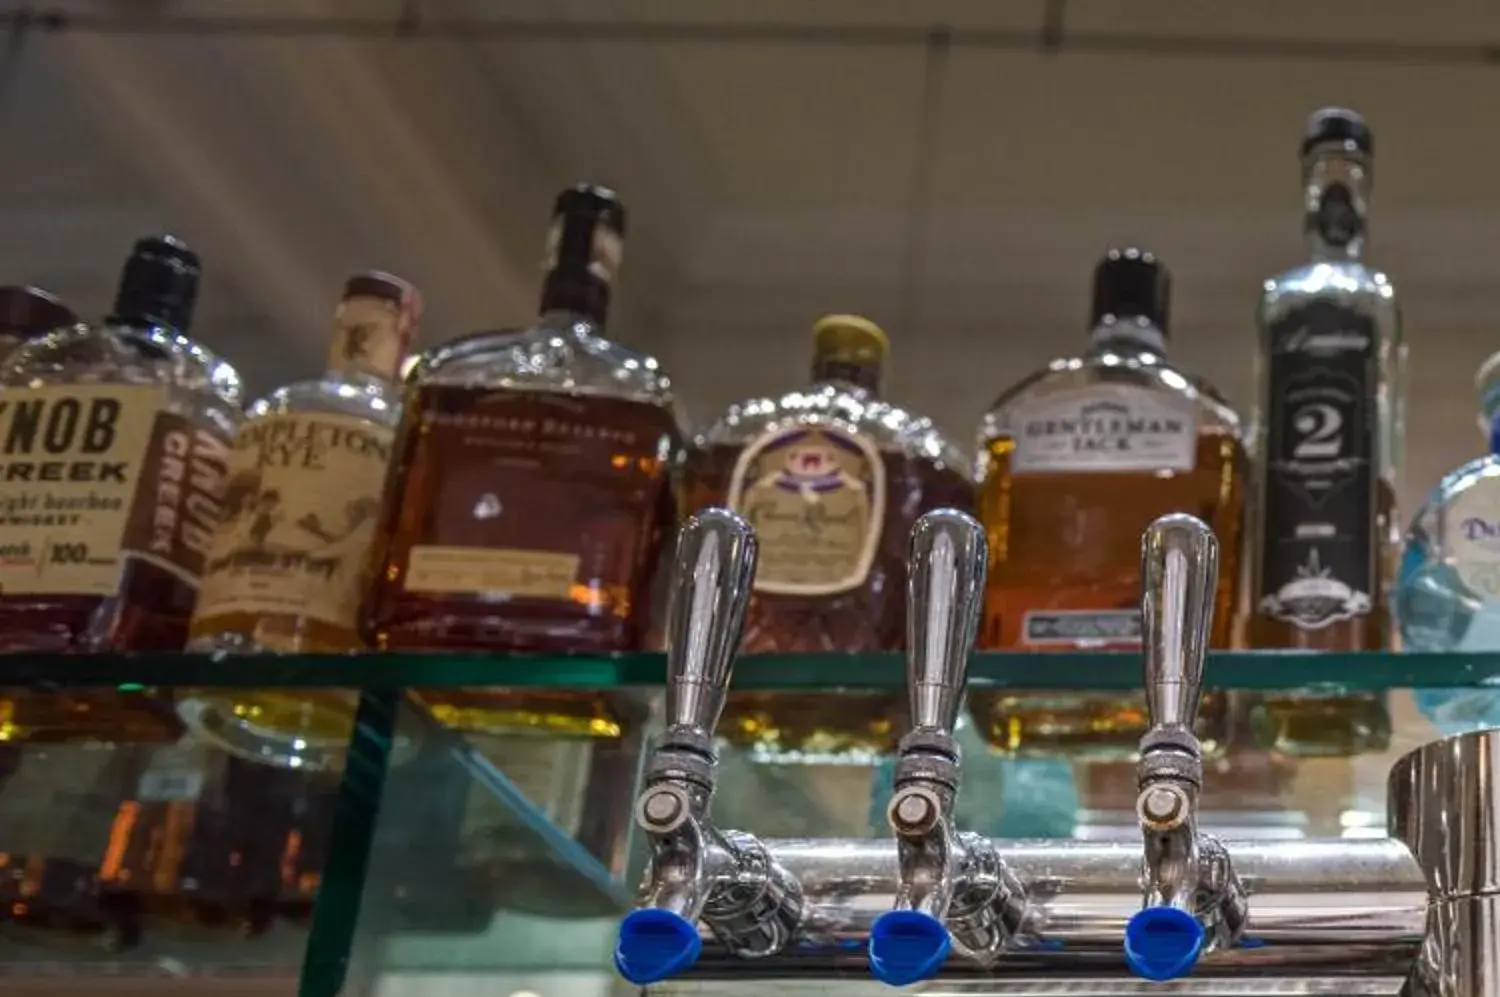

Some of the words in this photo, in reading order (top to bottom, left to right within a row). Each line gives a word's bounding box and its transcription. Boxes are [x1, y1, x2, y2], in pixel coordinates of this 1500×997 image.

[0, 397, 121, 454] NOB
[1024, 418, 1183, 438] GENTLEMAN
[1293, 403, 1344, 458] 2
[1072, 437, 1132, 453] JACK
[0, 461, 129, 483] REEK
